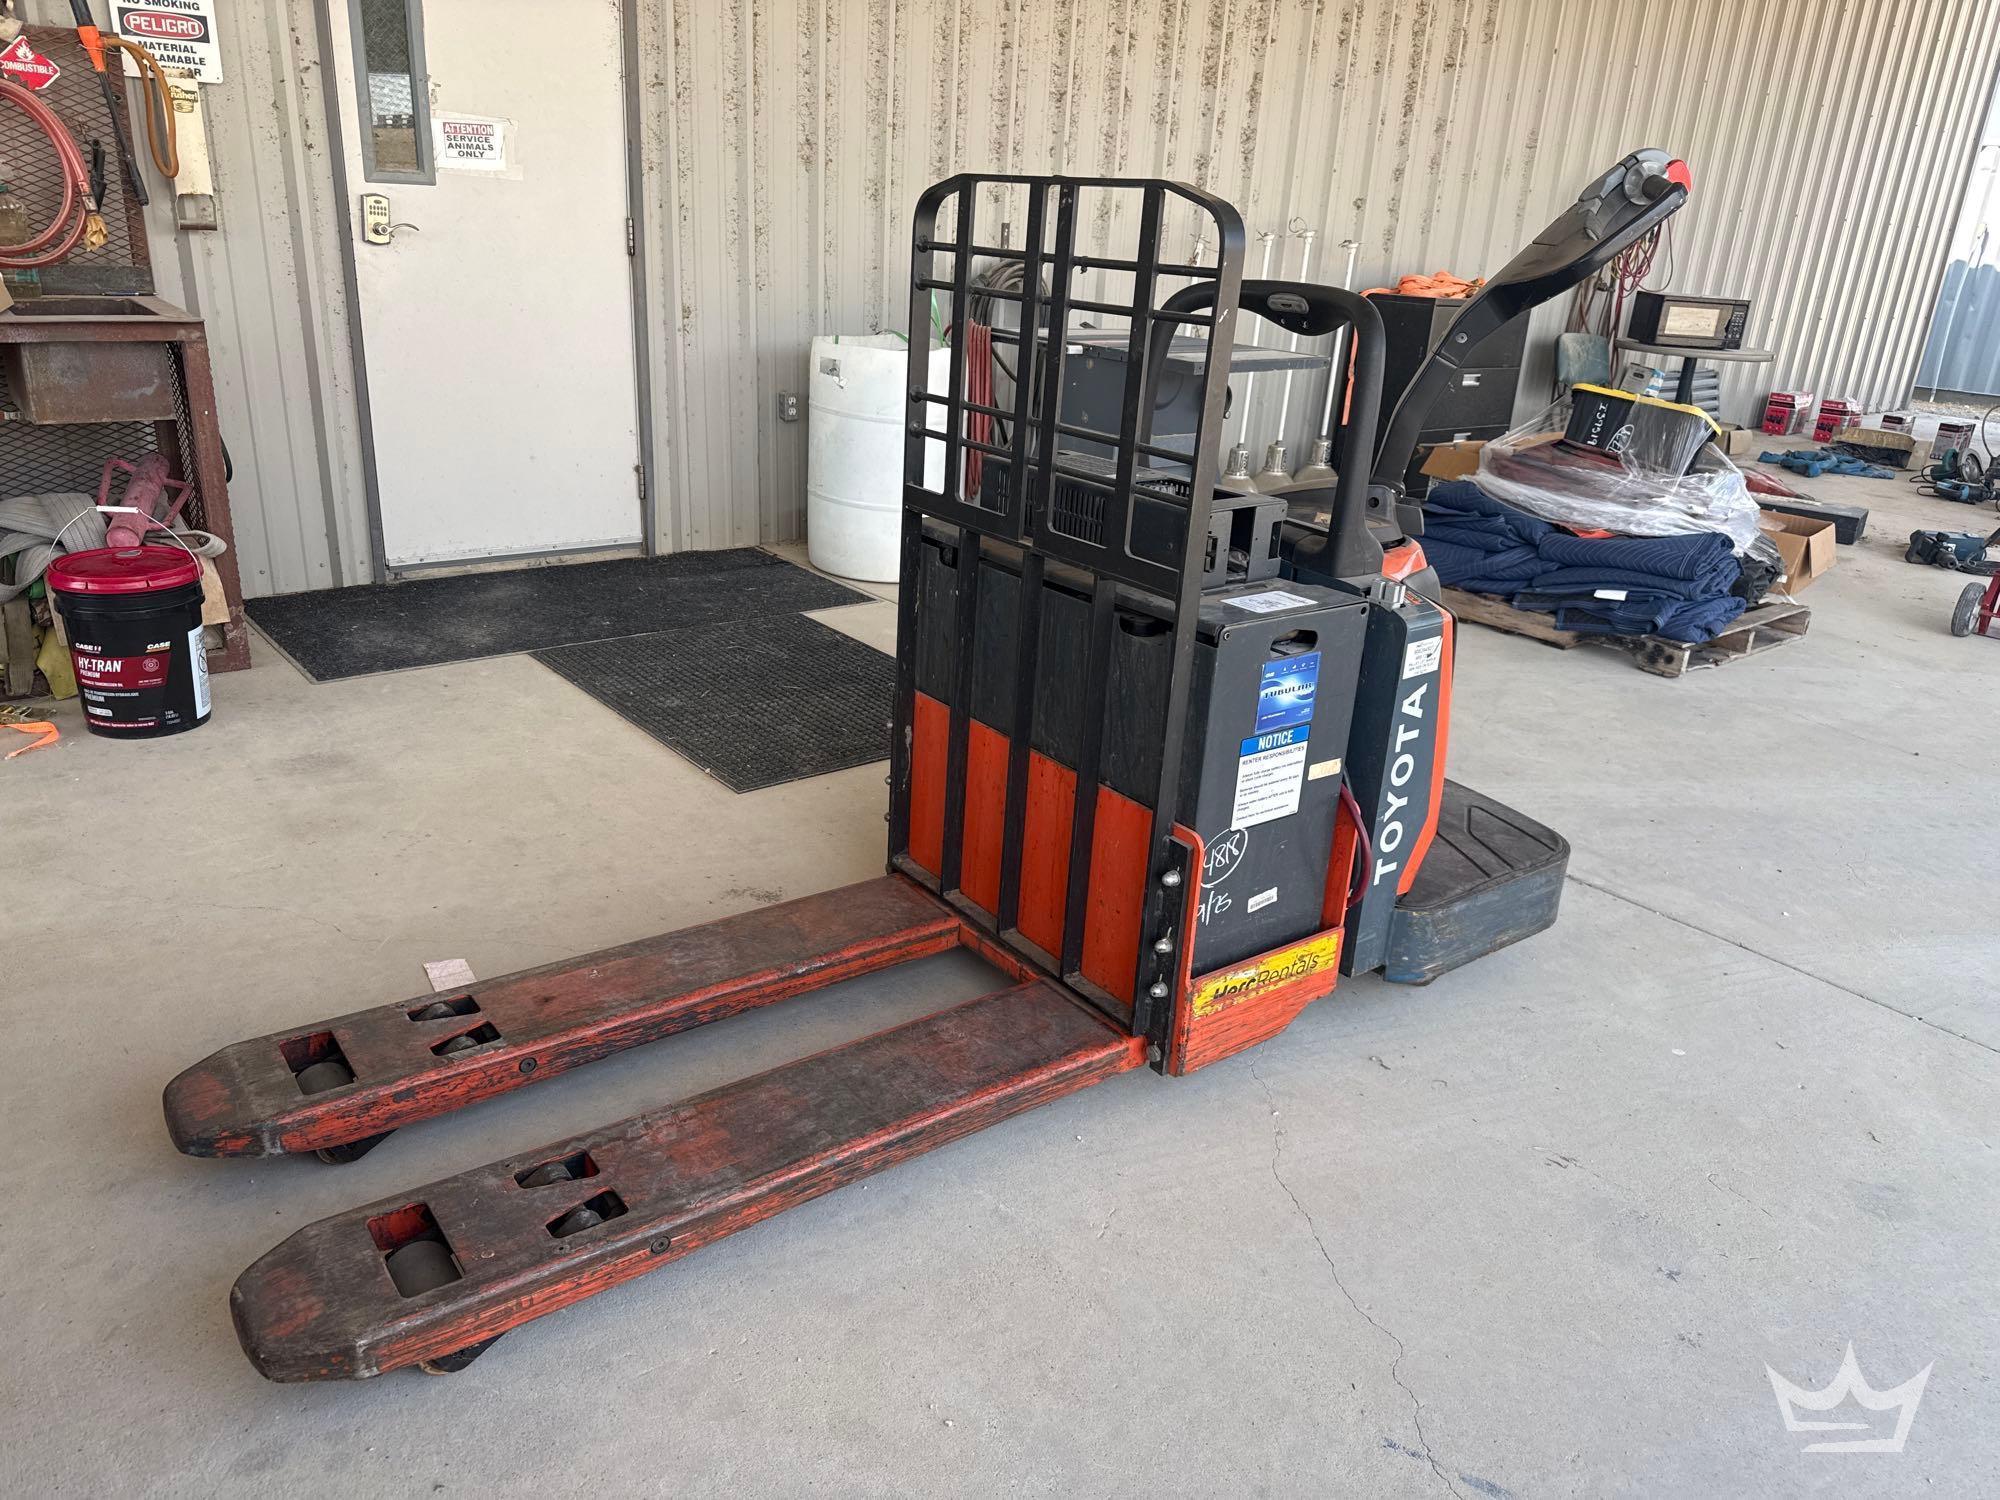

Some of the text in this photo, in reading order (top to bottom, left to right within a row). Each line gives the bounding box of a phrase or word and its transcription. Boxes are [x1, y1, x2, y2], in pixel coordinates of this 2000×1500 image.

[128, 15, 200, 36] PELIGRO
[138, 41, 197, 54] MATERIAL
[444, 123, 494, 135] ATTENTION
[446, 135, 491, 143] SERVICE
[447, 142, 494, 151] ANIMALS
[457, 150, 485, 158] ONLY
[75, 642, 94, 651] CASE
[146, 640, 171, 650] CASE
[78, 656, 122, 673] HY-TRAN
[1257, 729, 1295, 751] NOTICE
[1242, 756, 1262, 766] RENTER
[1373, 682, 1428, 886] TOYOTA
